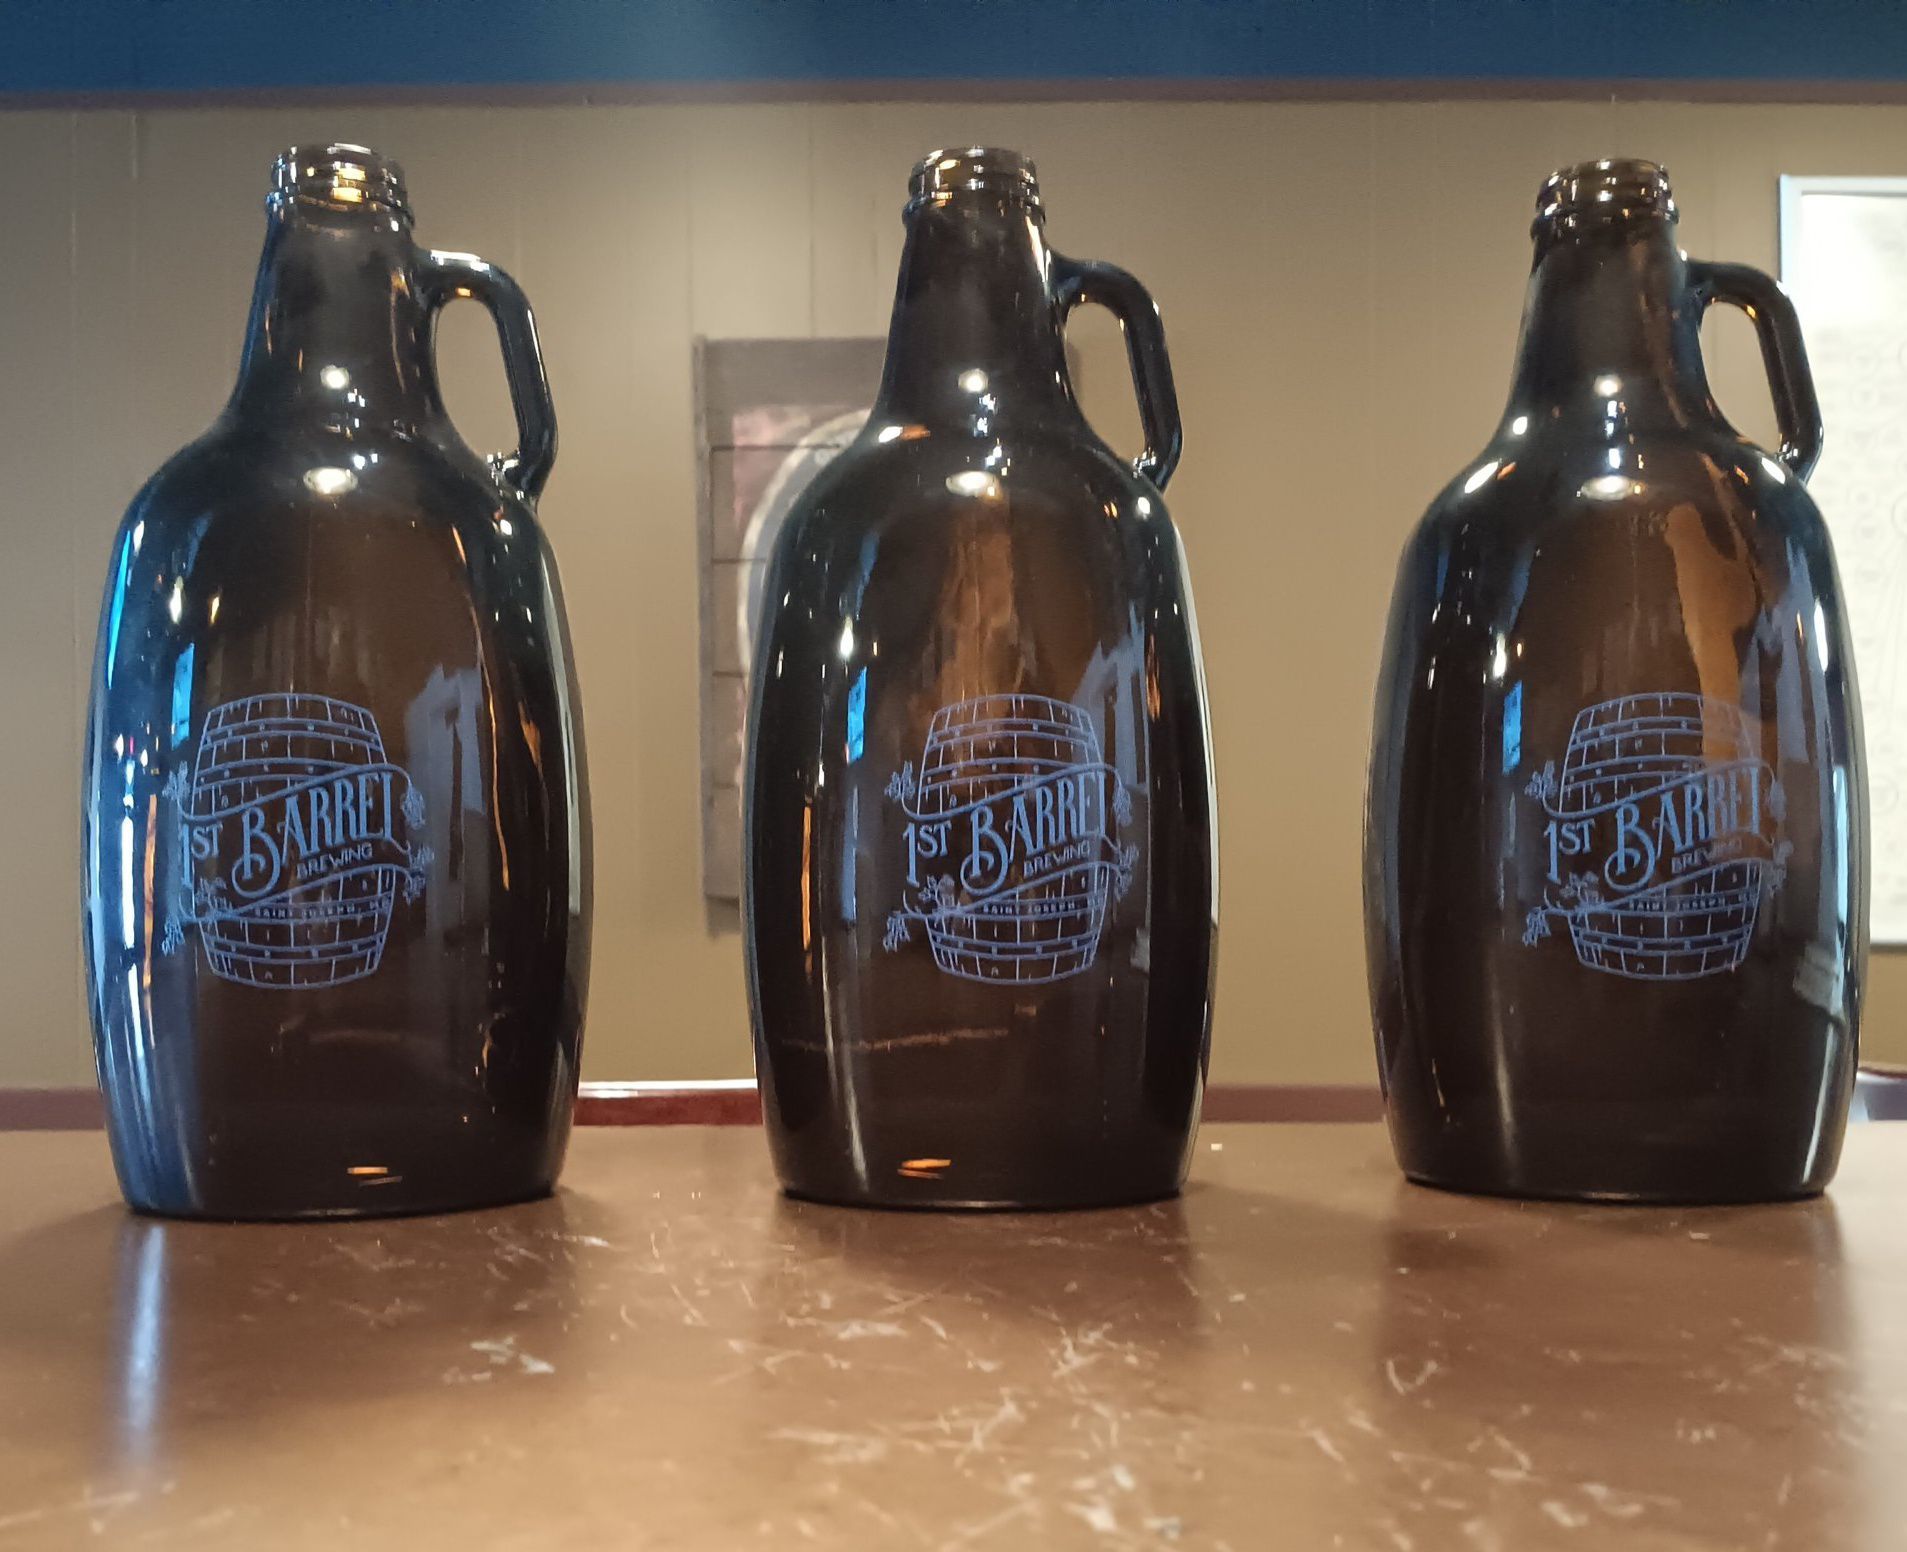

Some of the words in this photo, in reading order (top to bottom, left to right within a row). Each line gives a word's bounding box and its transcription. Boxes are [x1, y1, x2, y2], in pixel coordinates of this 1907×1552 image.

[296, 842, 373, 879] BREWING
[902, 822, 951, 888] 1ST
[1023, 840, 1091, 878] BREWING
[1543, 818, 1595, 885] 1ST
